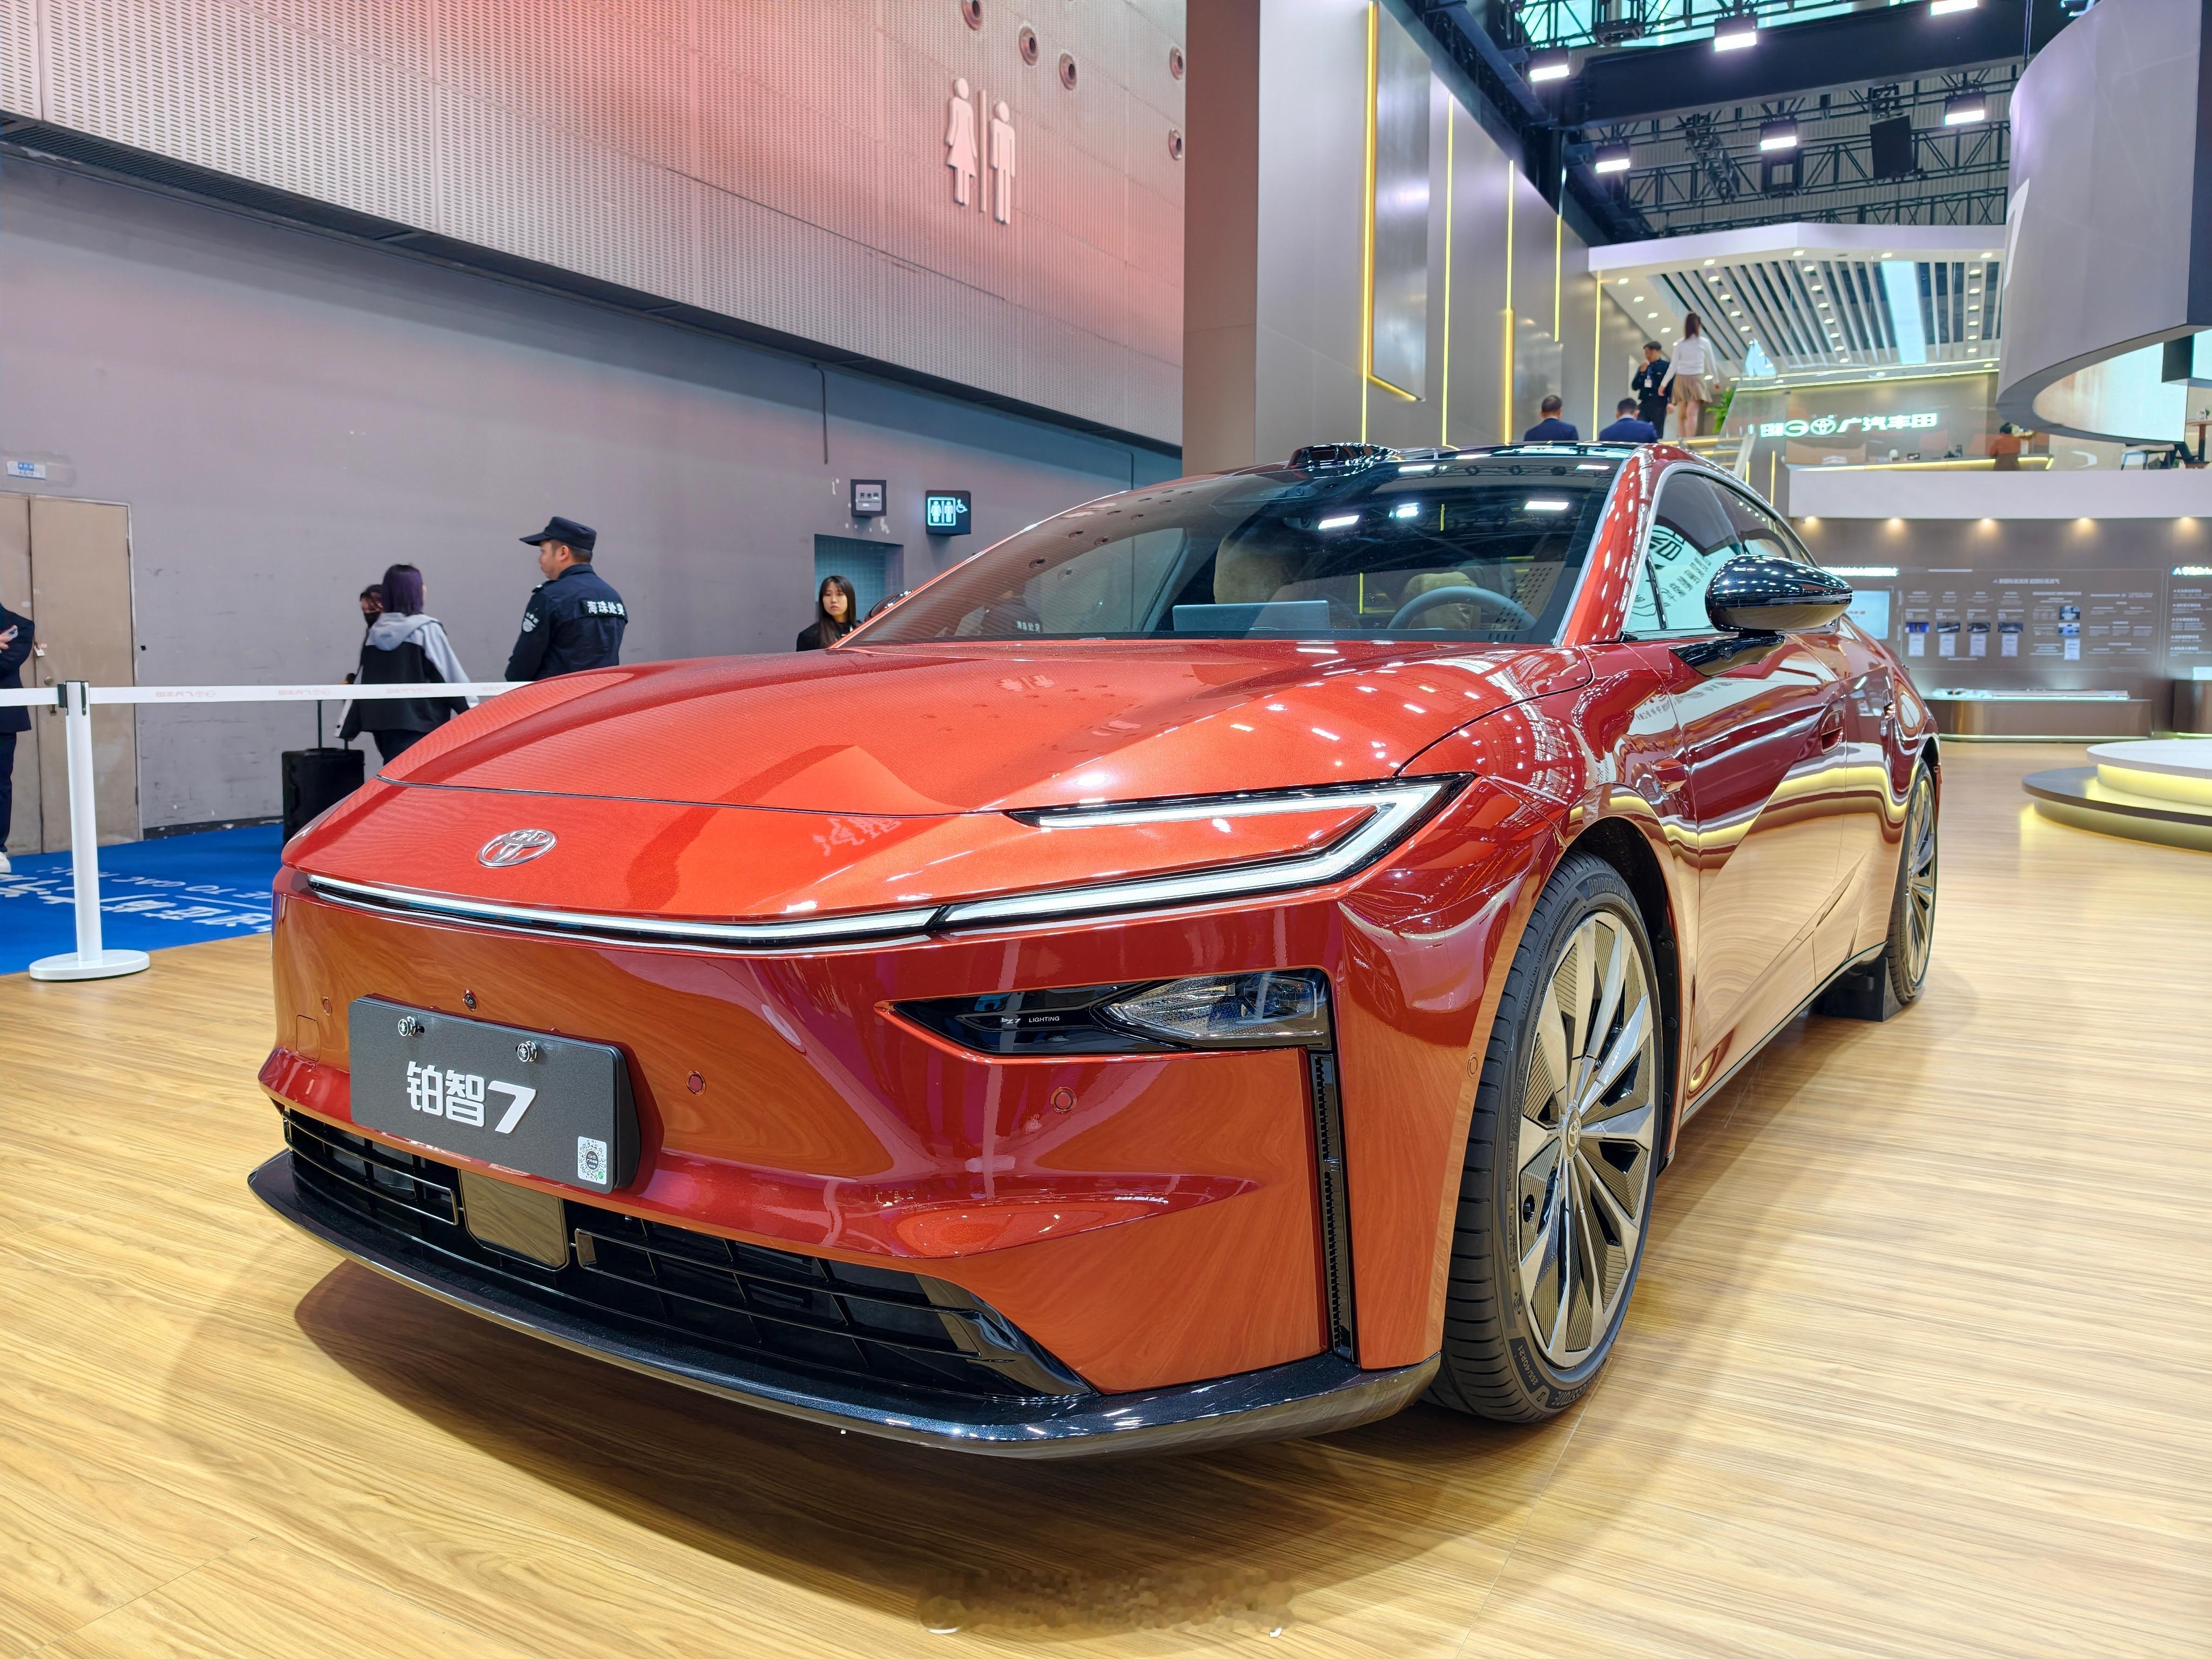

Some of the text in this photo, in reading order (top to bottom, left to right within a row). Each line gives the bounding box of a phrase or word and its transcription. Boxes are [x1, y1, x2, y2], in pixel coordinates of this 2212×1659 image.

[1837, 413, 1937, 433] 广汽丰田
[407, 1061, 536, 1134] 铂智7
[1518, 1345, 1539, 1386] 255/40R21
